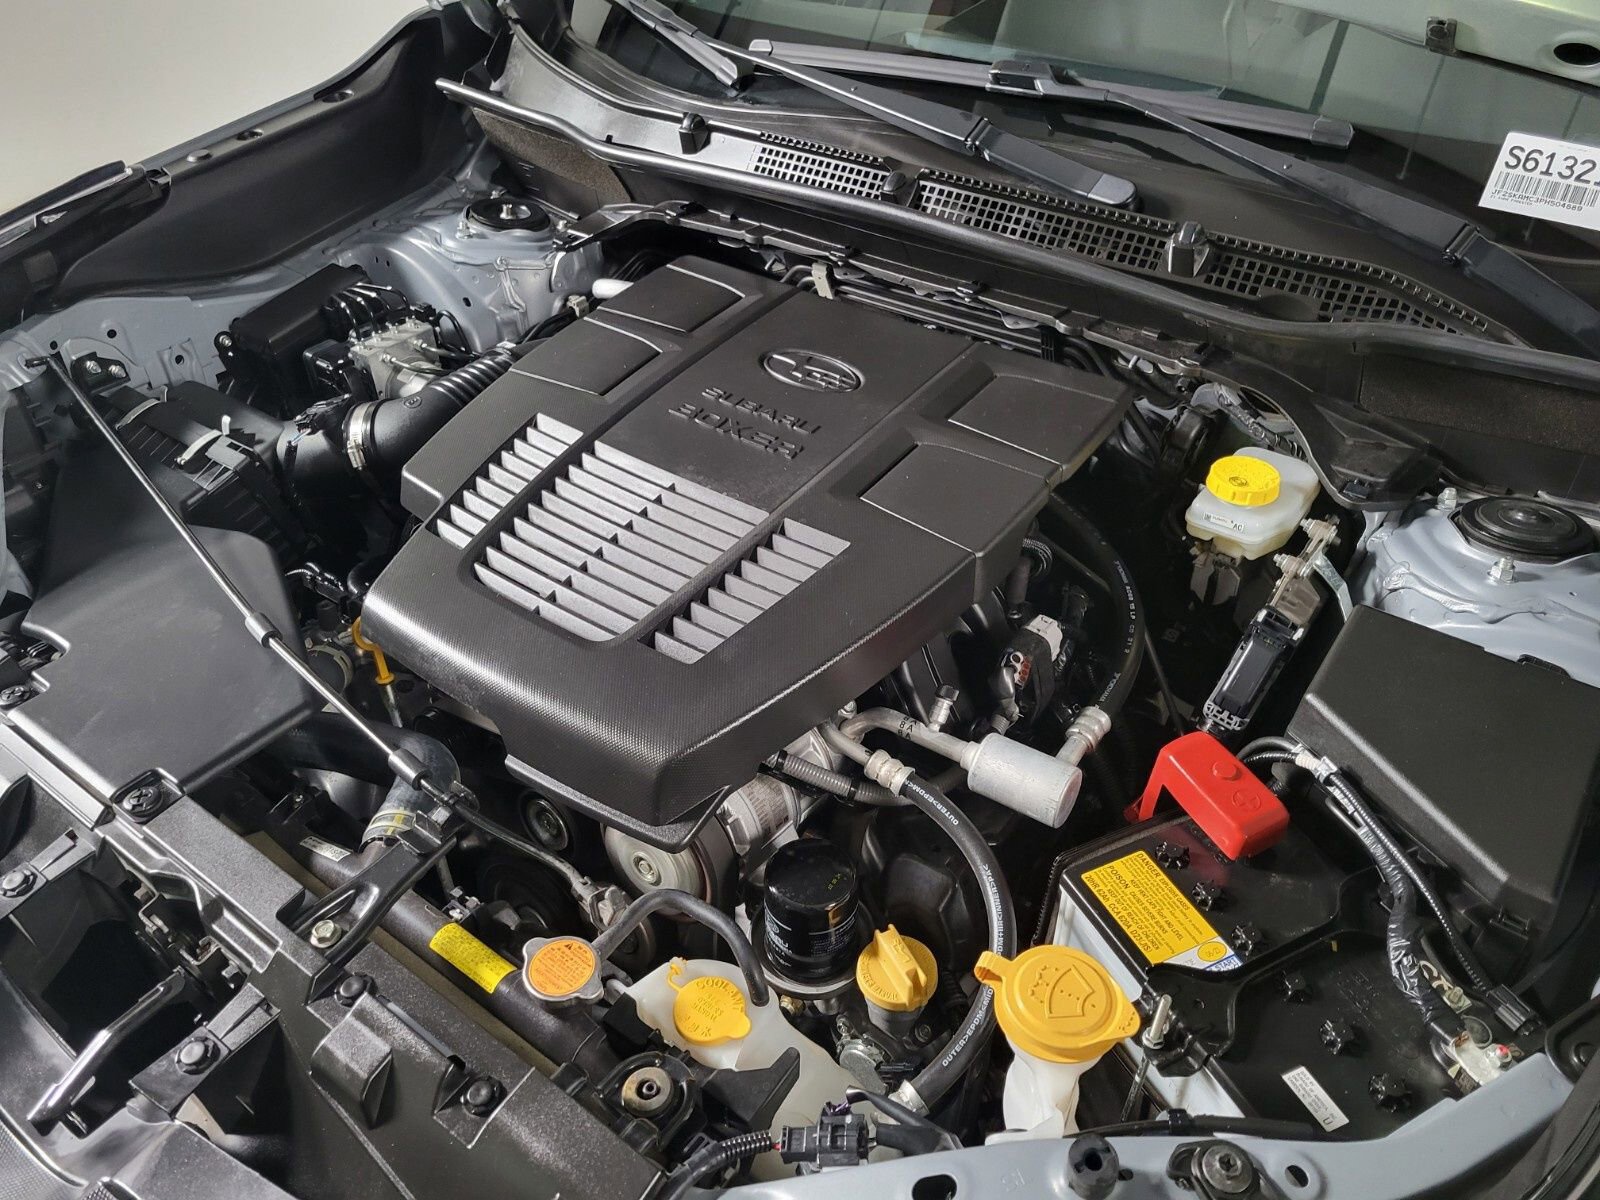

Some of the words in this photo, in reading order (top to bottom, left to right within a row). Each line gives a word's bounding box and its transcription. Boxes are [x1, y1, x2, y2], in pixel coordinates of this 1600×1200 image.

[1504, 145, 1600, 187] S6132
[701, 386, 822, 434] SUBARU
[668, 402, 804, 460] BOXER
[1107, 865, 1130, 889] POISON
[1136, 853, 1160, 877] DANGER
[1108, 903, 1121, 915] CCA
